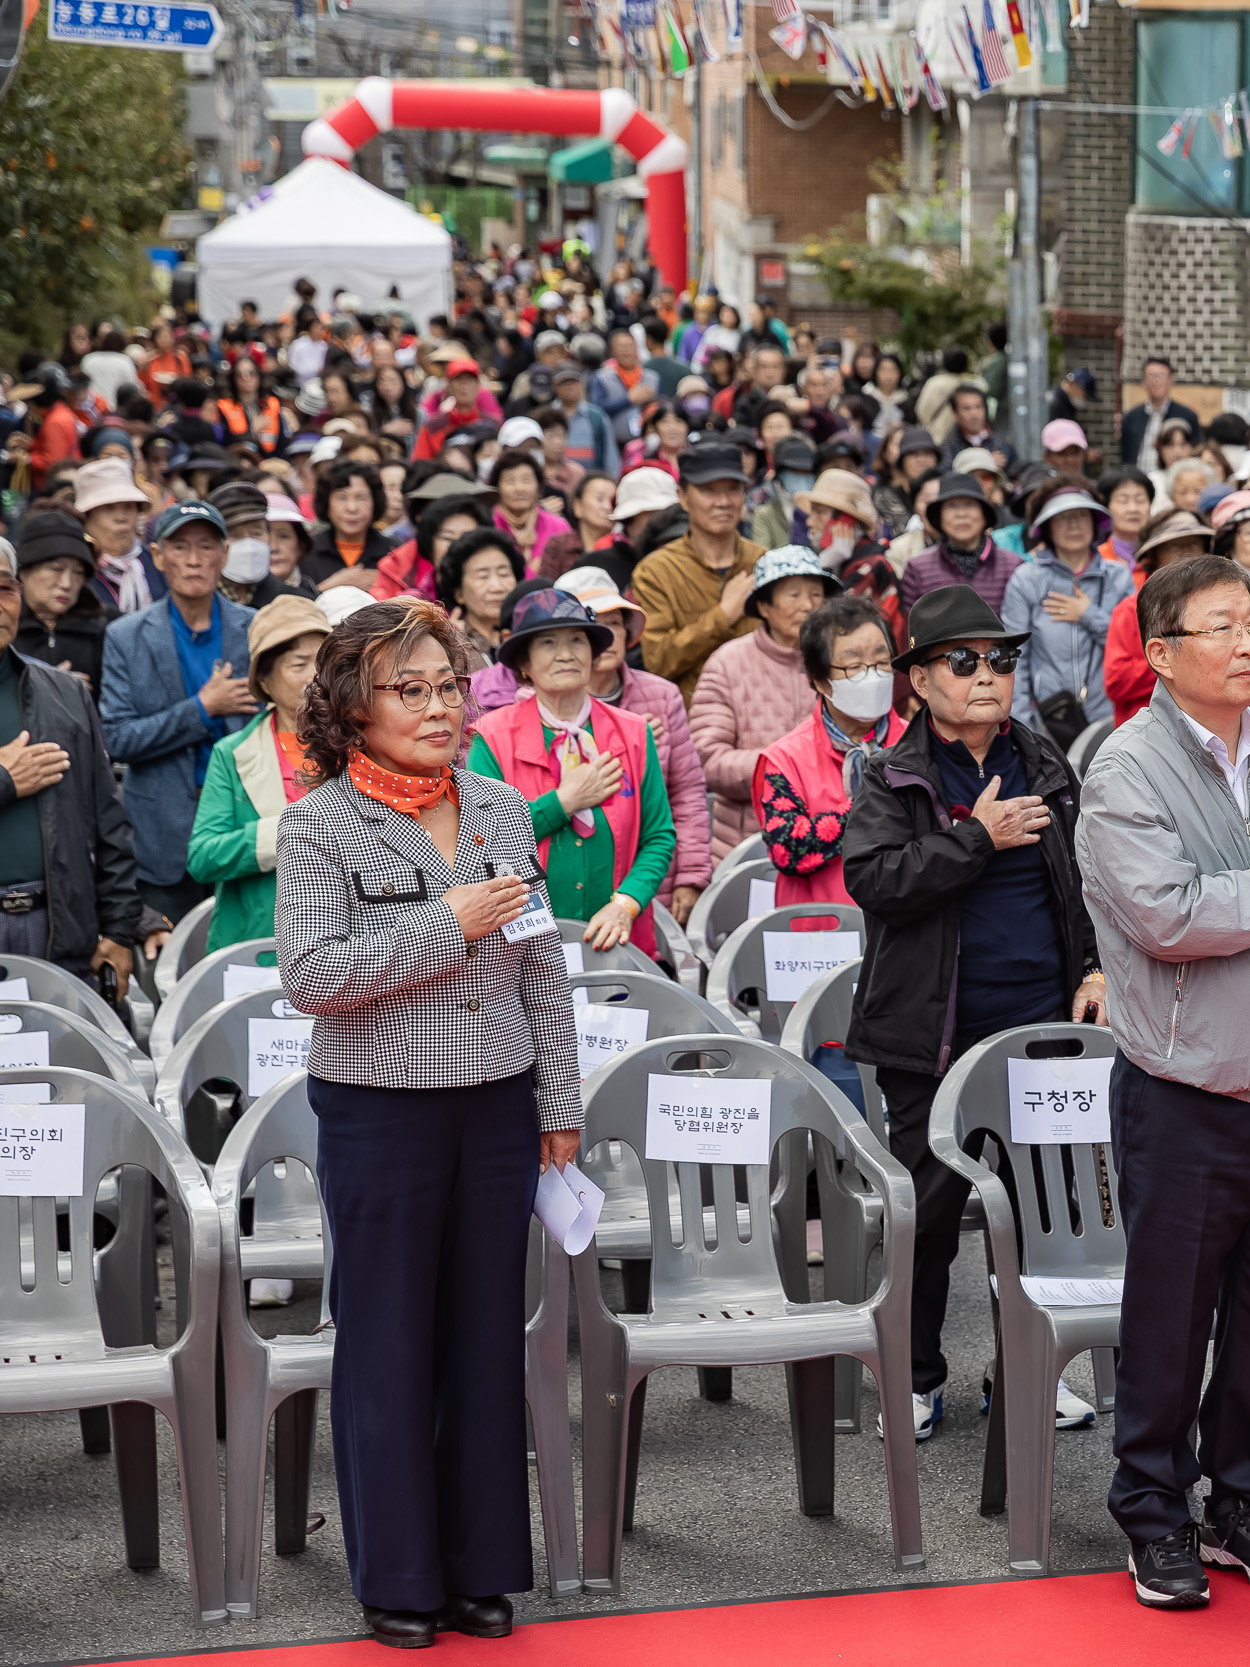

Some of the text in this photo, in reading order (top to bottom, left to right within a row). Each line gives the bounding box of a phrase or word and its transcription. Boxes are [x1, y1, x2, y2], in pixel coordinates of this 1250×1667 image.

[505, 917, 536, 935] 김경희
[774, 960, 846, 972] 화양지구대
[1023, 1089, 1097, 1113] 구청장
[658, 1103, 760, 1120] 국민의힘 광진을
[674, 1119, 744, 1135] 당협위원장
[0, 1145, 37, 1161] 의장
